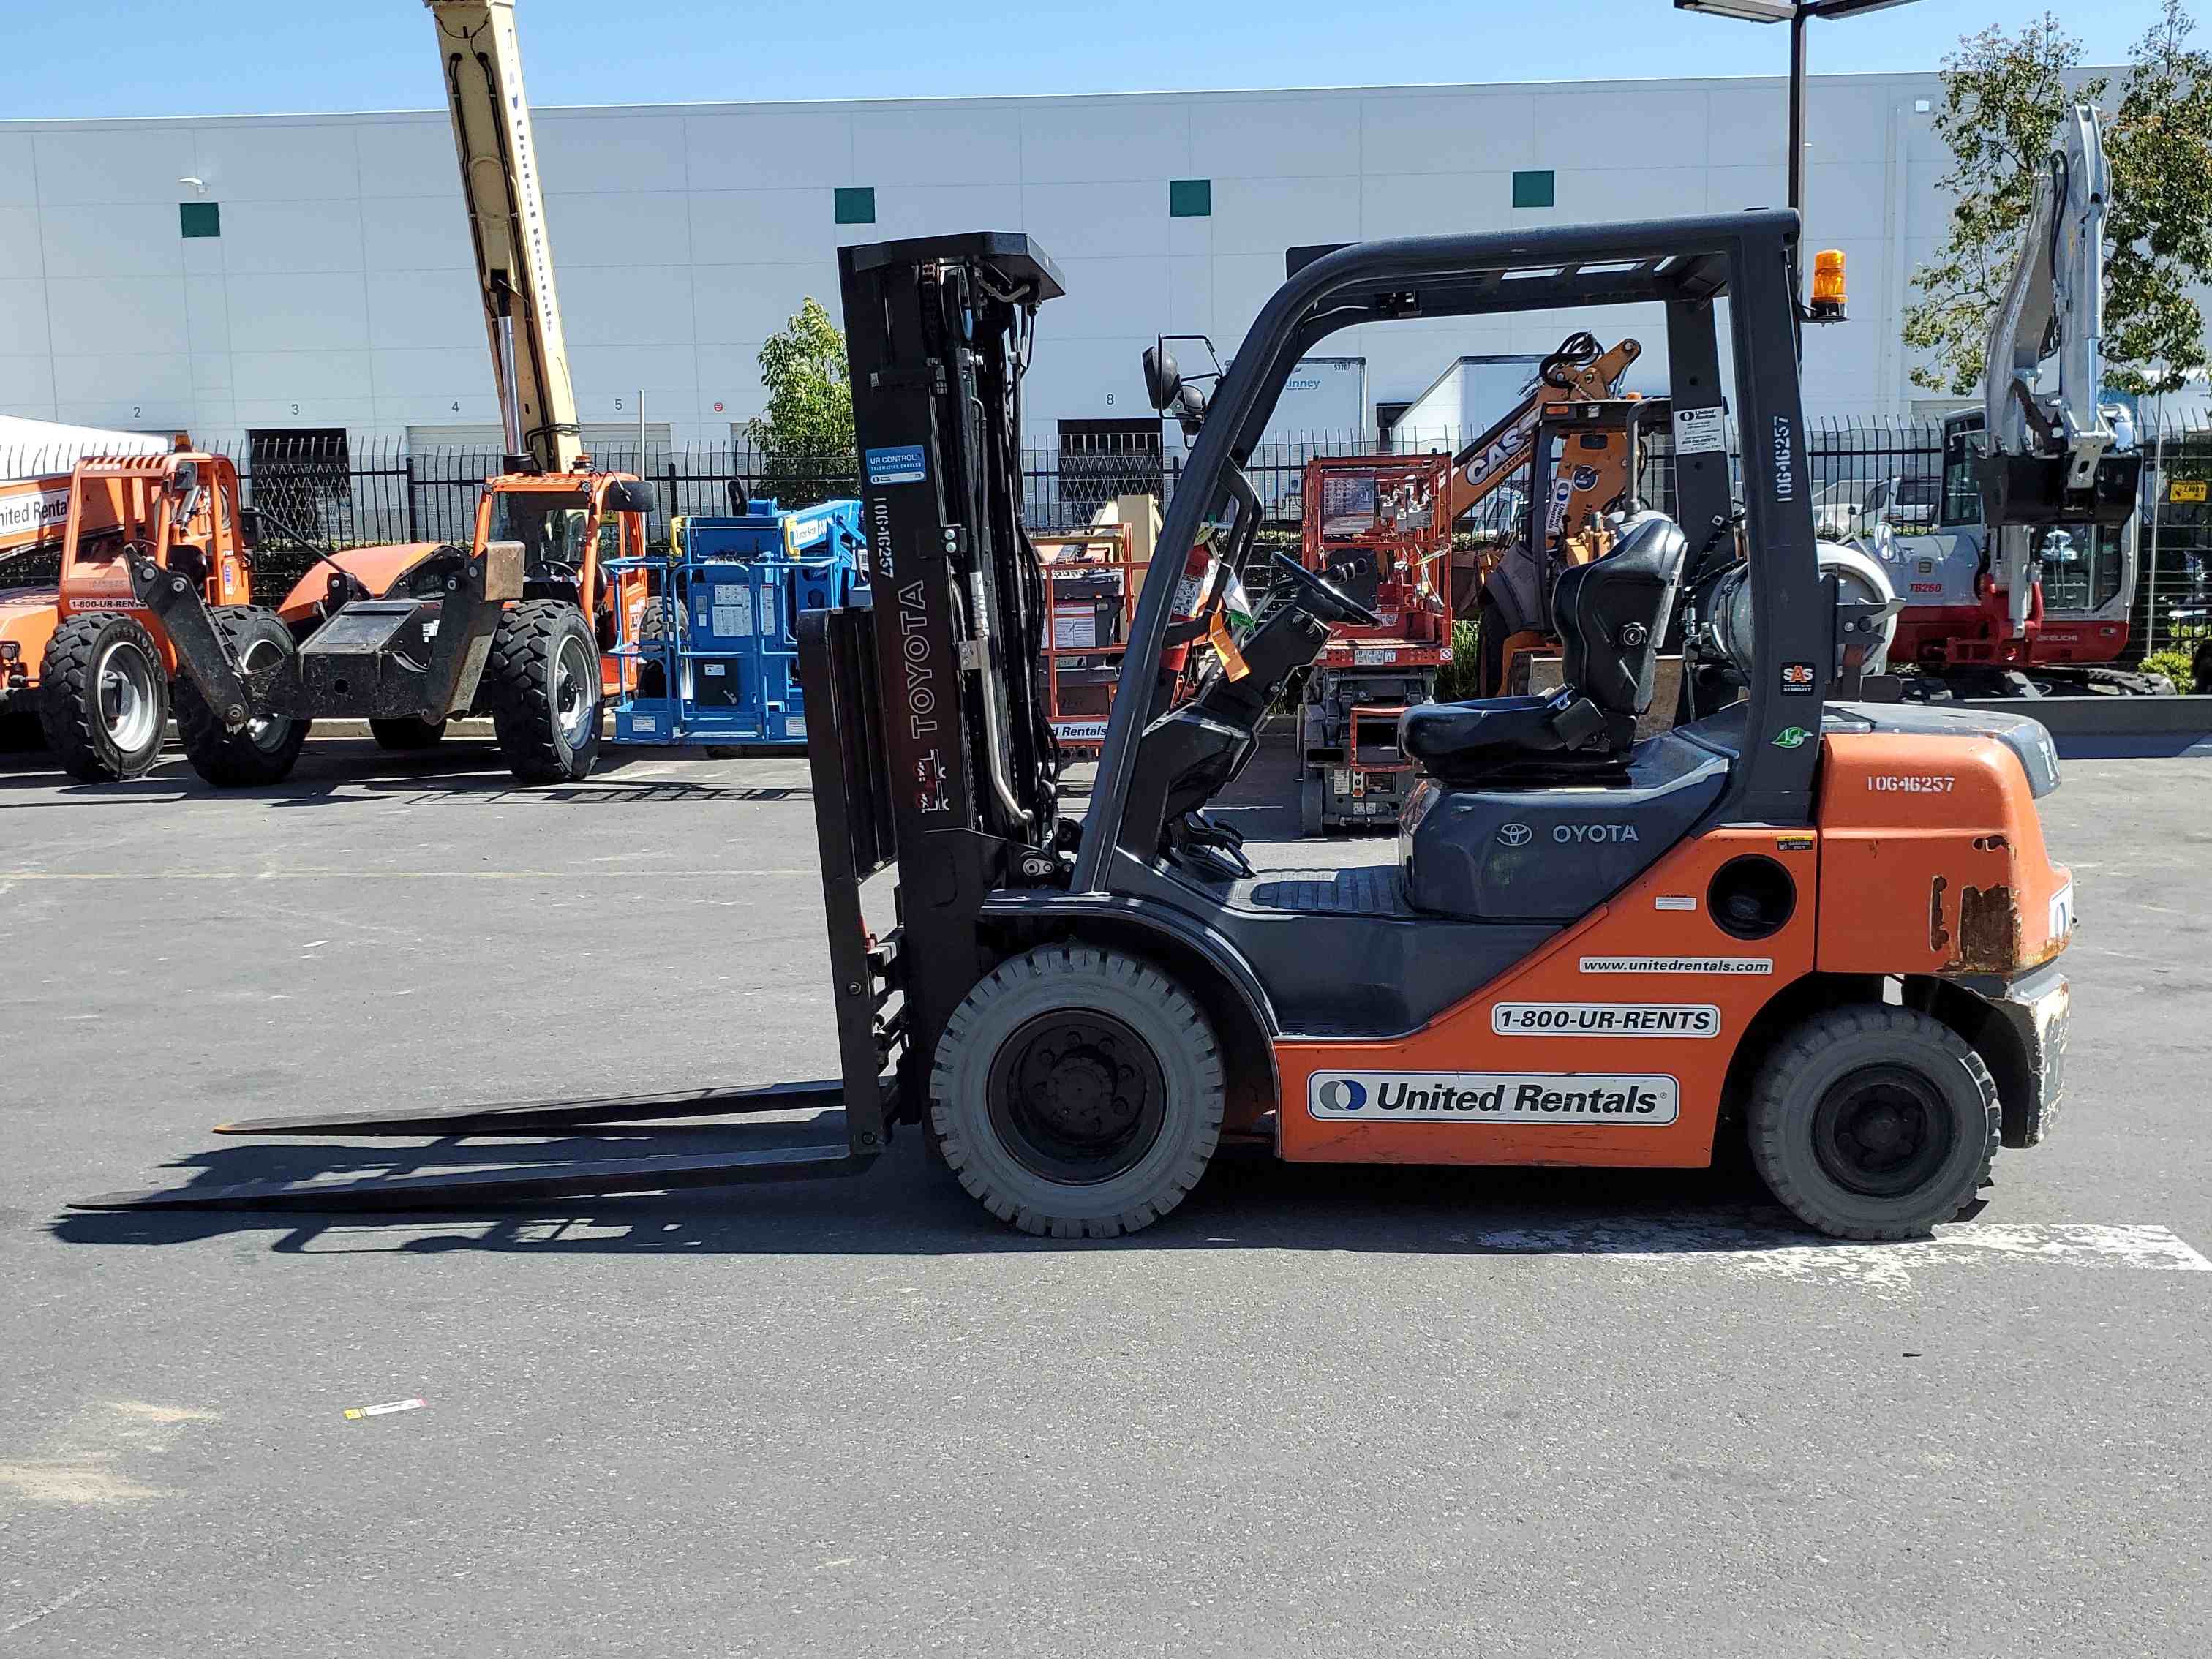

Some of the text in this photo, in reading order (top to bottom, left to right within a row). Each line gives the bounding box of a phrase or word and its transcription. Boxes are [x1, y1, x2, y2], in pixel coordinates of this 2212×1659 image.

[1287, 378, 1320, 390] inney
[451, 401, 460, 412] 4
[614, 399, 622, 410] 5
[1106, 394, 1114, 405] 8
[133, 407, 141, 418] 2
[292, 403, 300, 415] 3
[870, 454, 917, 465] UR CONTROL
[1773, 415, 1793, 502] 10646257
[33, 494, 70, 521] Renta
[873, 497, 895, 579] 10646257
[898, 579, 938, 740] TOYOTA
[1783, 665, 1814, 683] SAS
[1061, 725, 1108, 737] Rentals
[1867, 775, 1955, 792] 10646257
[1552, 824, 1639, 843] OYOTA
[1584, 959, 1769, 972] www.unitedrentals.com
[1500, 1009, 1711, 1030] 1-800-UR-RENTS
[1377, 1082, 1658, 1113] United Rentals
